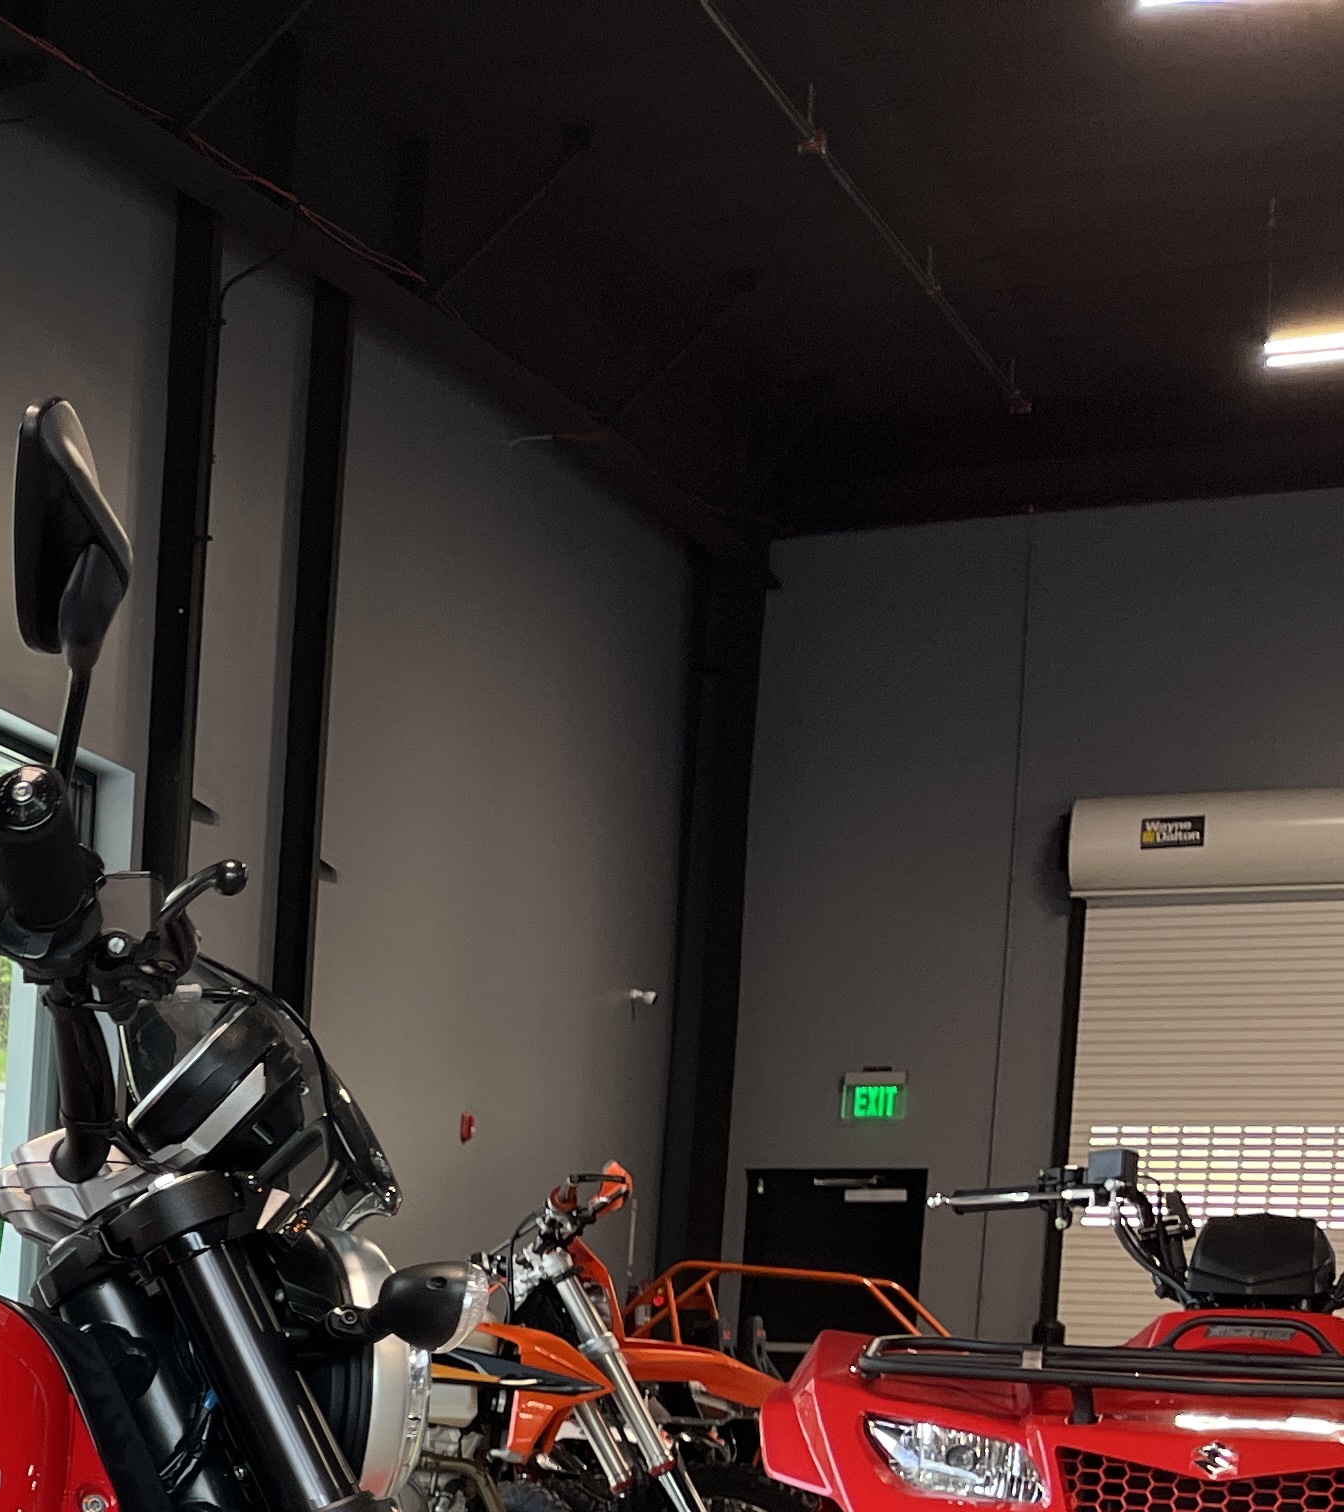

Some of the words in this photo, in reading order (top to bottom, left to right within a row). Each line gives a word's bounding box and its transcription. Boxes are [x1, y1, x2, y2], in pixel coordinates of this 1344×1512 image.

[1145, 821, 1192, 833] Wayne
[1156, 831, 1200, 842] Dalton
[854, 1086, 898, 1117] EXIT
